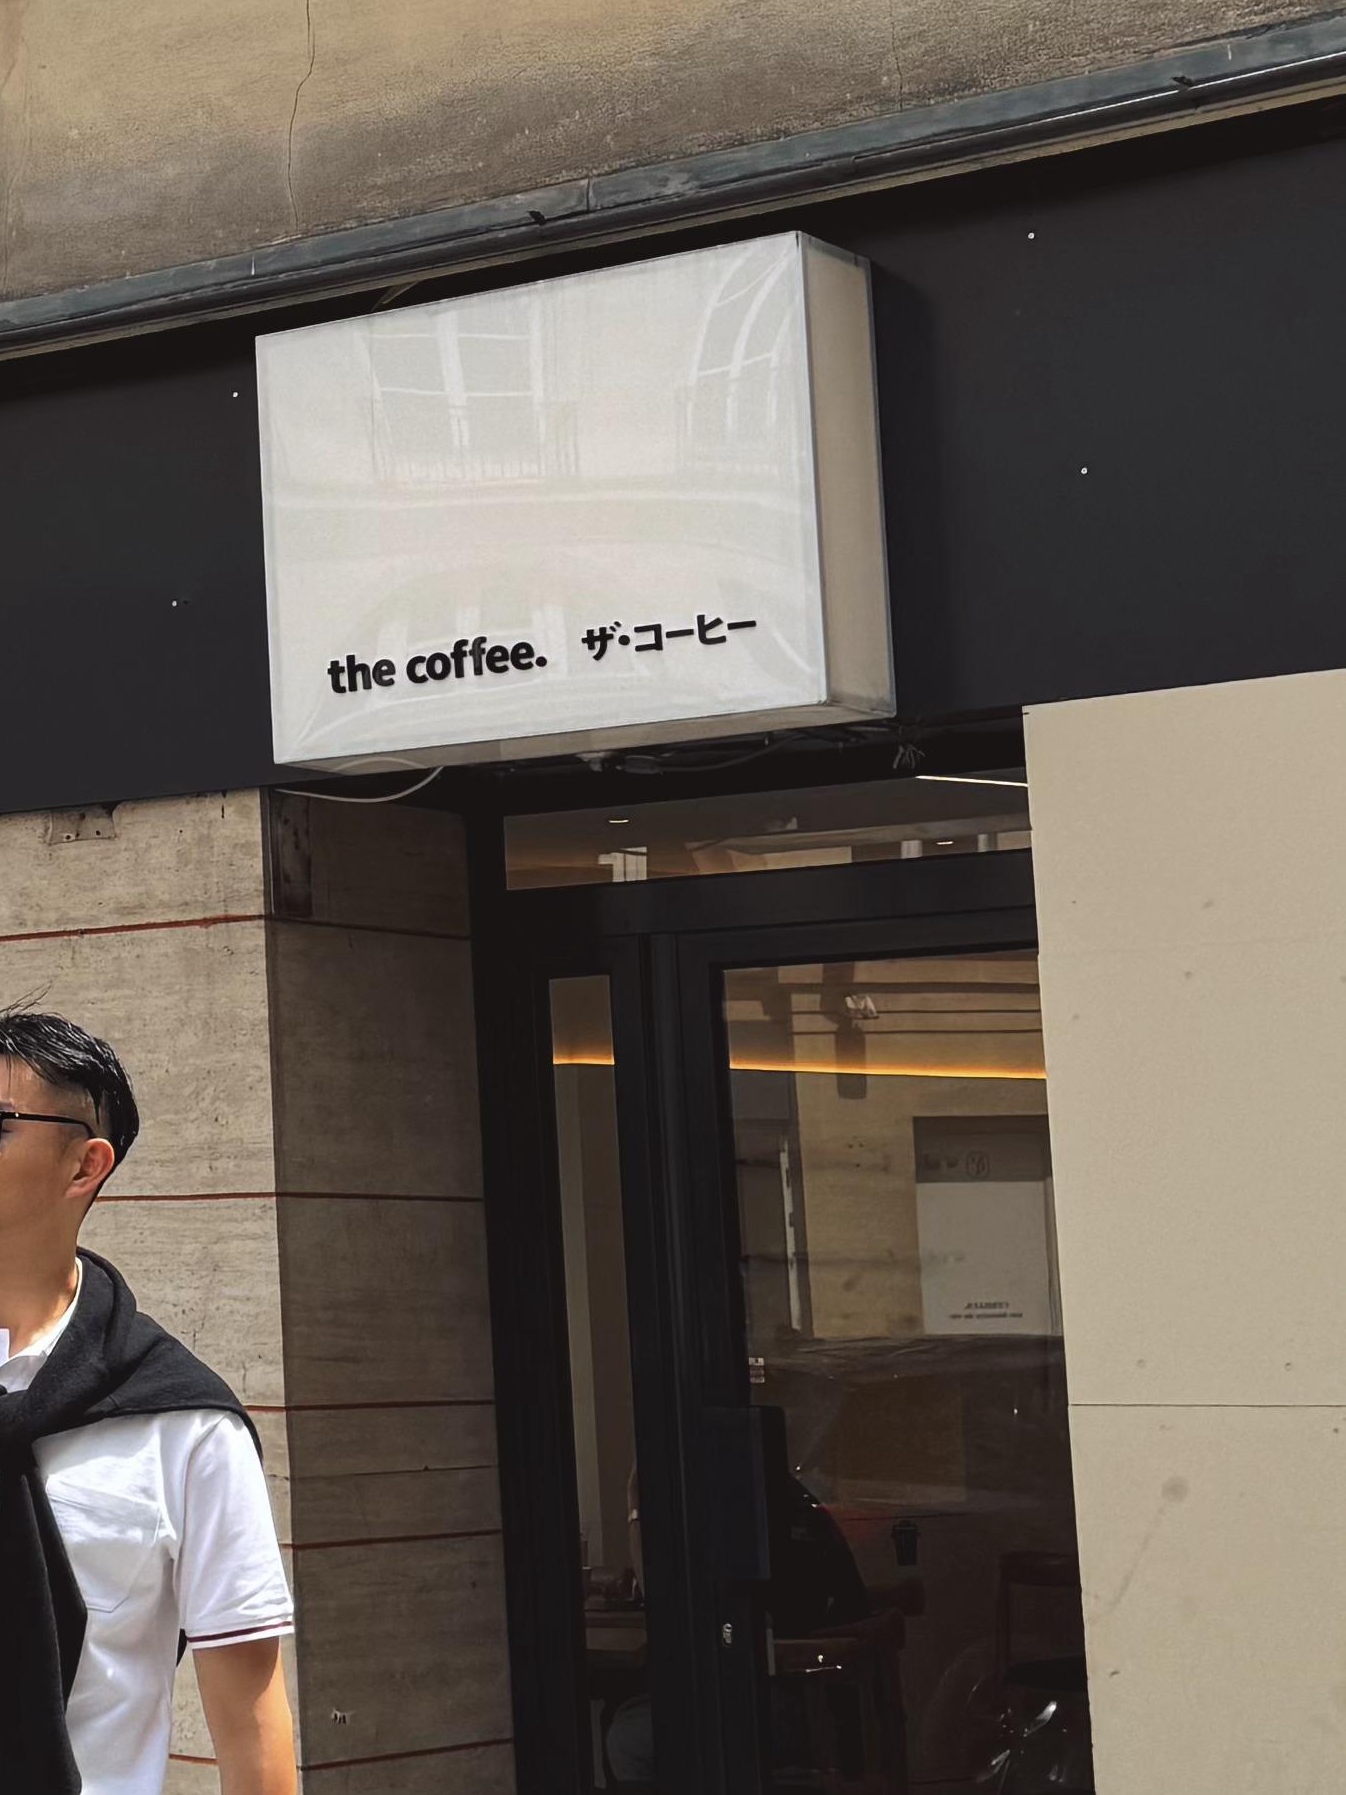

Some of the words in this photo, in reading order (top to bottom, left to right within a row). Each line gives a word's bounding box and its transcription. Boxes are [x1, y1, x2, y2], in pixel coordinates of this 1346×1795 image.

[581, 614, 757, 661] ザ・コーヒー
[327, 654, 396, 694] the
[406, 636, 548, 684] coffee.
